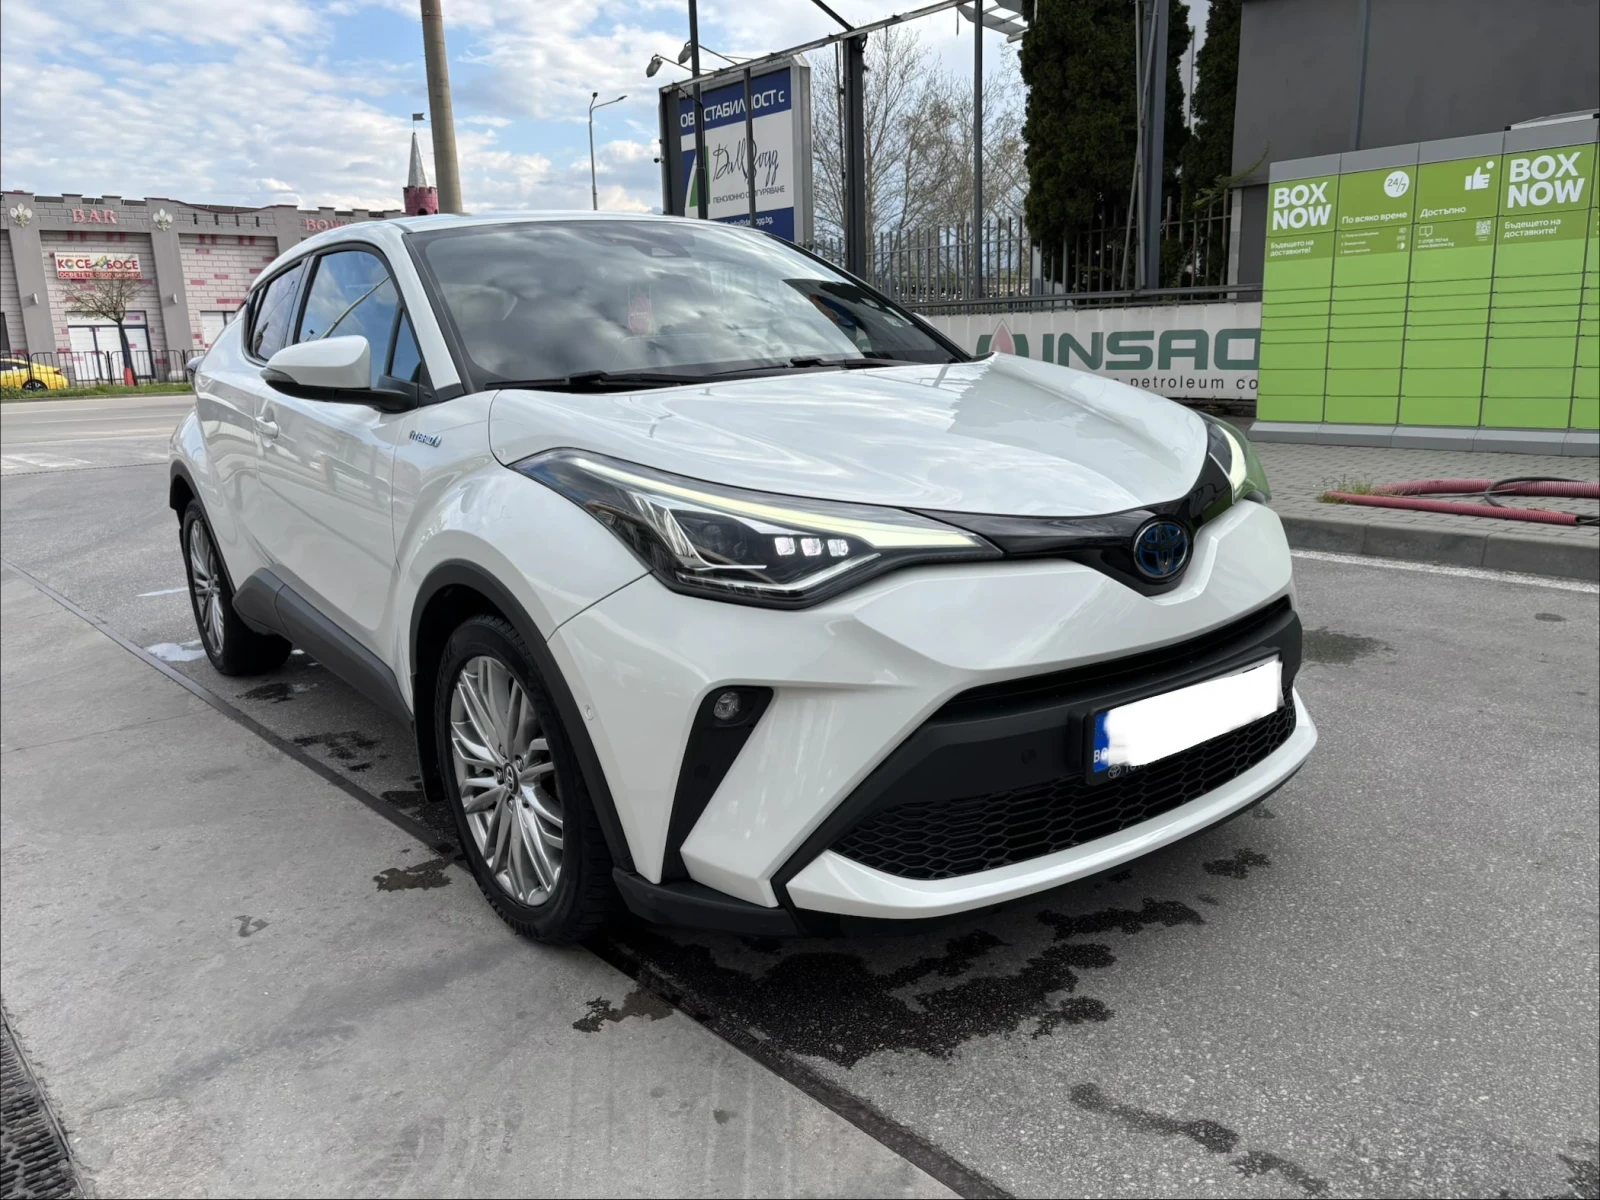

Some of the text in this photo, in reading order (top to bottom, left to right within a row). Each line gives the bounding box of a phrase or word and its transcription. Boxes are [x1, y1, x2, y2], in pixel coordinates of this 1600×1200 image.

[680, 112, 695, 128] ОВ
[703, 89, 777, 122] СТАБИЛОСТ
[1509, 152, 1582, 183] BOX
[1387, 176, 1407, 192] 24/7
[712, 185, 785, 204] ПЕНСИОННО ОГУРЯВАНЕ
[1273, 181, 1329, 209] BOX
[1507, 177, 1586, 209] NOW
[72, 208, 117, 224] BAR
[1272, 204, 1332, 231] NOW
[1341, 212, 1408, 224] По всяко време
[1420, 206, 1467, 219] Достъпно
[306, 218, 347, 233] BOW
[1504, 219, 1549, 229] Бъдещето
[1503, 226, 1557, 239] доставките!
[1269, 247, 1312, 257] доставките!
[1270, 240, 1305, 249] Бъдещето
[57, 259, 139, 270] КОСЕ БОСЕ
[1130, 375, 1224, 389] petroleum
